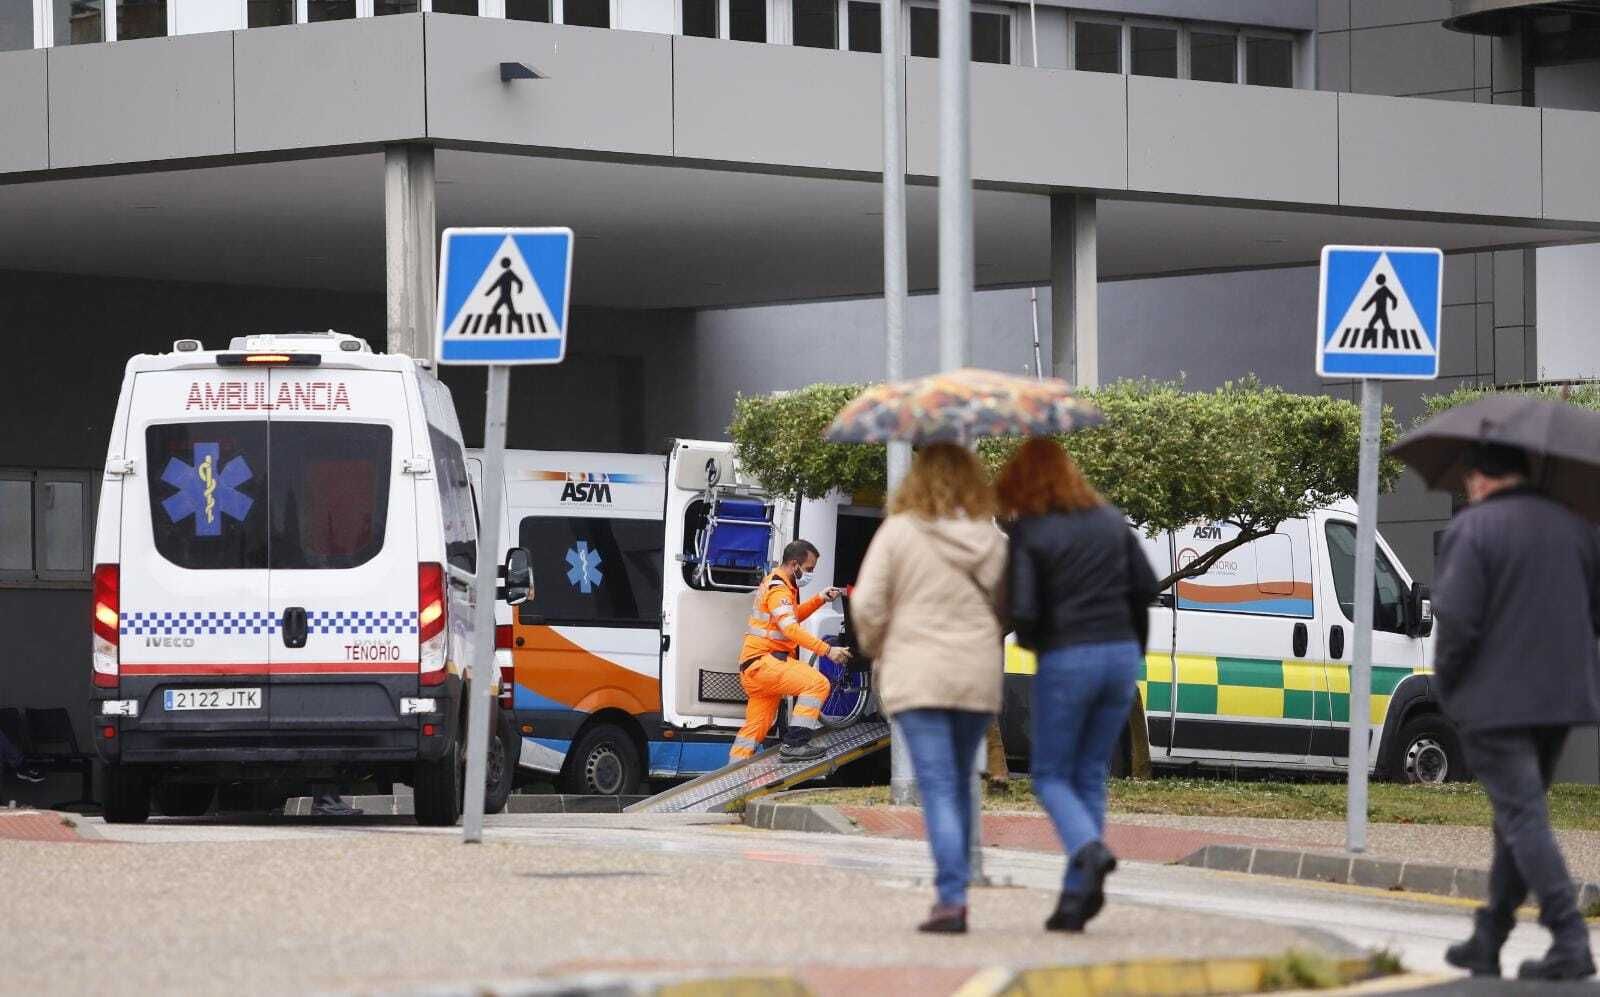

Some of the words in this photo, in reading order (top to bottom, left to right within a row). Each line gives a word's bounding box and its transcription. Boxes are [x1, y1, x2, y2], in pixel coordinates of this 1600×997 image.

[185, 382, 351, 410] AMBULANCIA
[560, 482, 612, 503] ASM
[1193, 526, 1222, 540] ASM
[145, 637, 195, 648] IVECO
[344, 645, 400, 660] TENORIO
[176, 691, 220, 708] 2122
[226, 690, 257, 707] JTK
